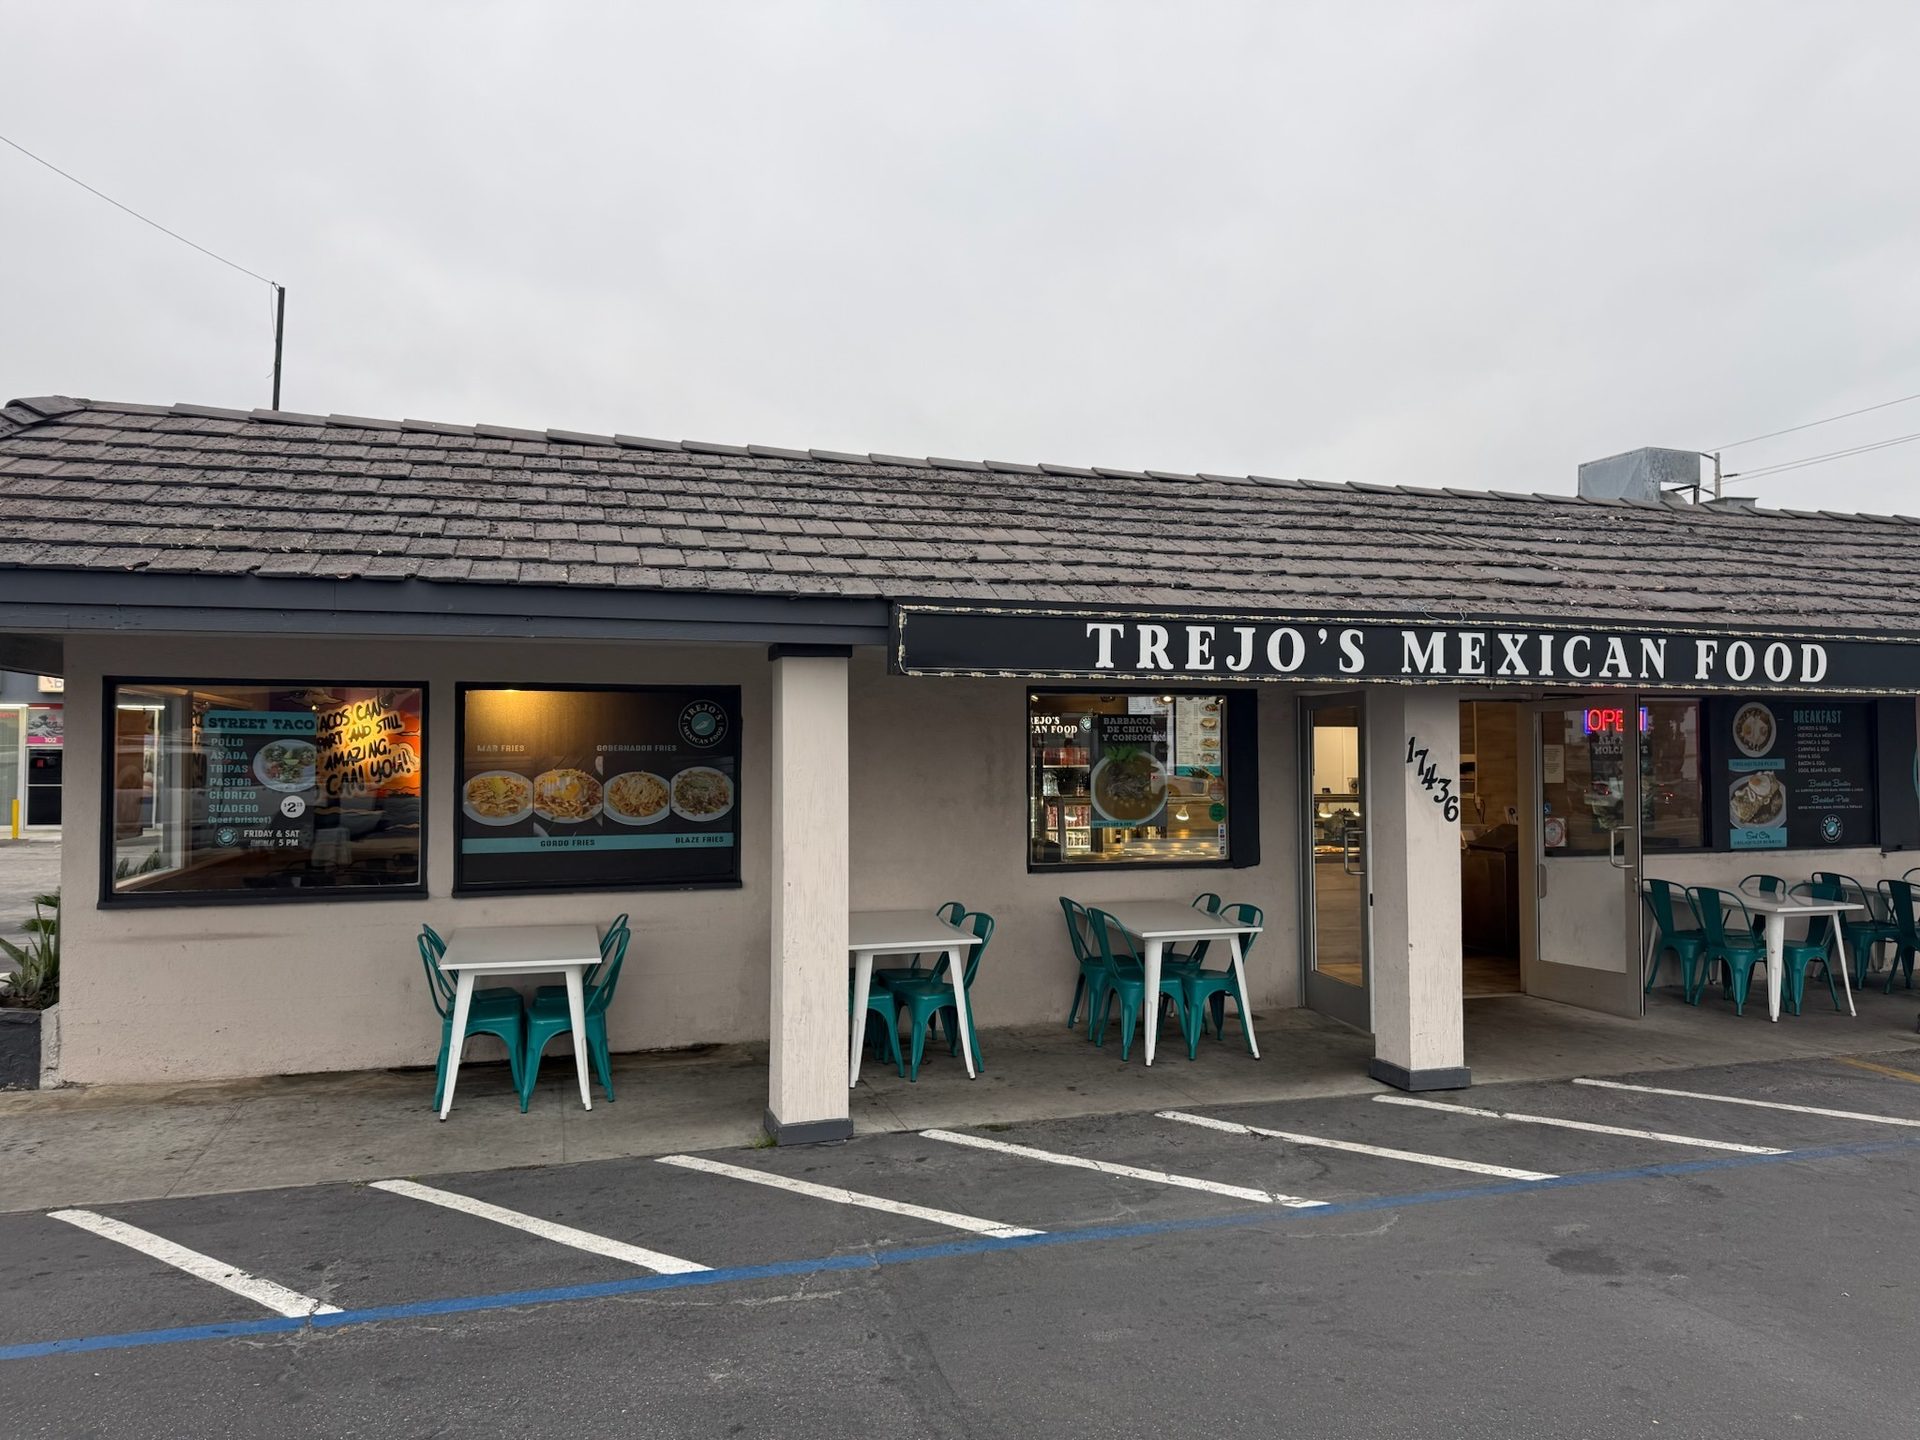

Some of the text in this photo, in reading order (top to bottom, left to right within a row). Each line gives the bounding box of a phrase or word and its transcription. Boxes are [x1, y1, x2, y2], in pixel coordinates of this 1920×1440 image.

[1086, 623, 1828, 683] TREJO'S MEXICAN FOOD
[355, 701, 382, 721] CAN
[683, 704, 724, 721] TREJO'S
[1103, 717, 1156, 725] BARBACOA
[1793, 709, 1842, 724] BREAKFAST
[208, 717, 315, 730] STREET TACO
[349, 725, 372, 742] AND
[376, 714, 403, 734] STILL
[1051, 725, 1078, 734] FOOD
[683, 725, 709, 745] MEXICAN
[211, 738, 244, 747] POLLO
[477, 744, 525, 752] MAR FRIES
[596, 744, 677, 752] GOBERNADOR FRIES
[210, 751, 248, 760] ASADA
[210, 764, 249, 773] TRIPAS
[209, 777, 252, 787] PASTOR
[1406, 737, 1459, 822] 17436
[209, 791, 256, 800] CHORIZO
[208, 804, 259, 813] SUADERO
[234, 816, 272, 825] brisket)
[243, 829, 300, 838] FRIDAY & SAT
[278, 839, 284, 847] 5
[285, 839, 299, 847] PM
[572, 839, 595, 847] FRIES
